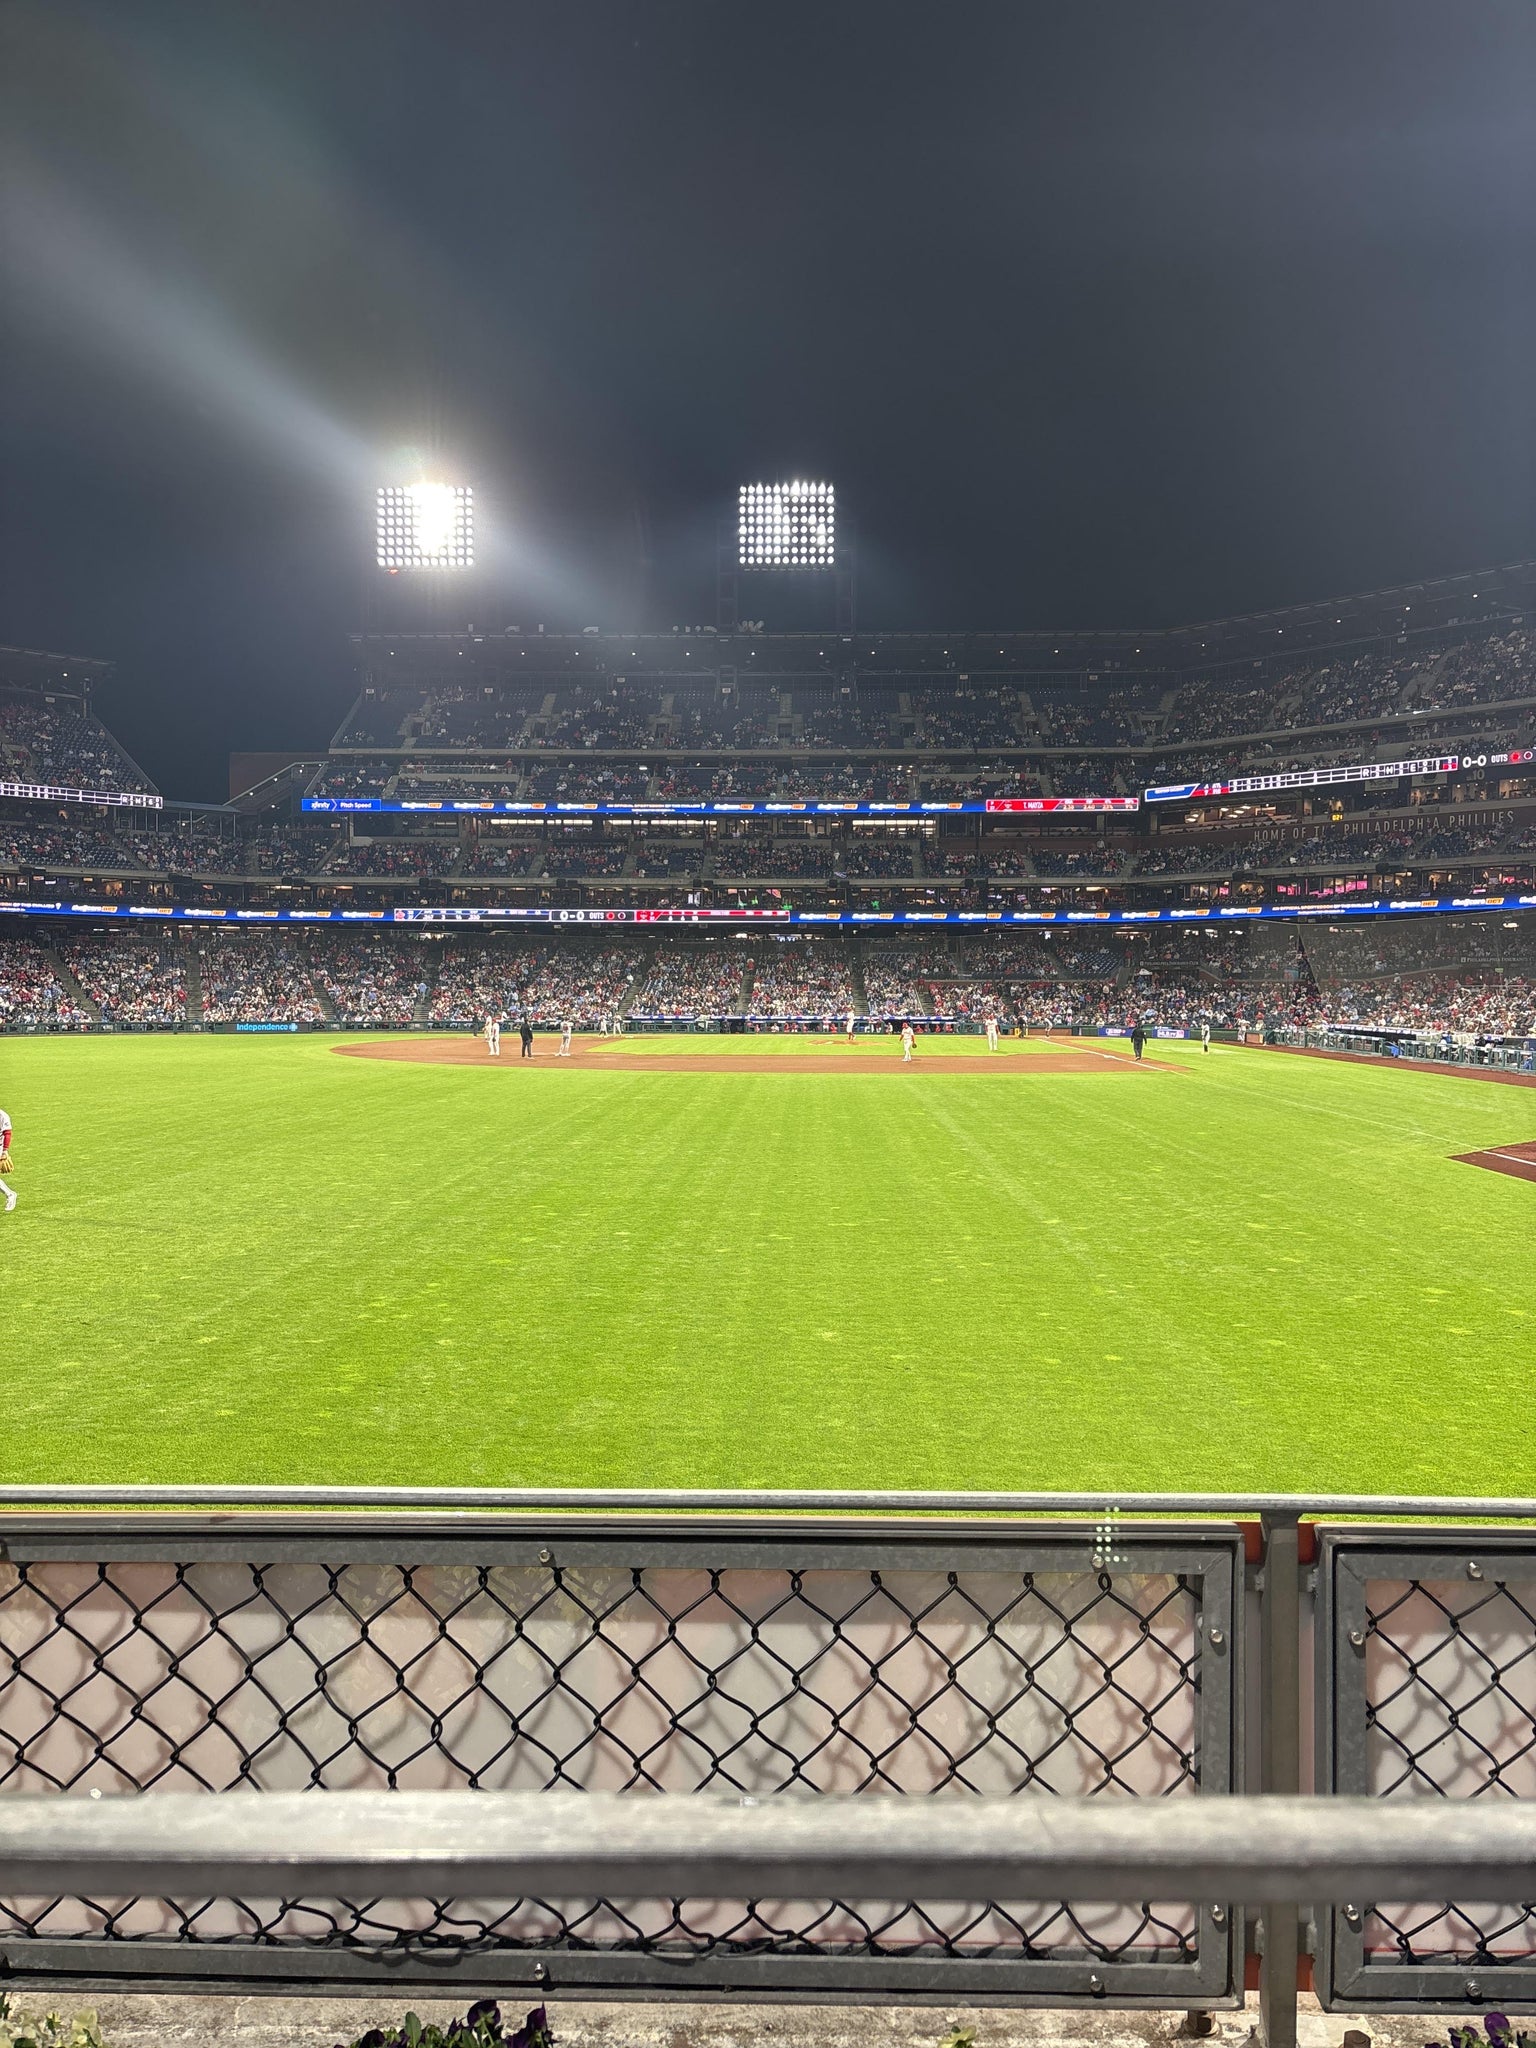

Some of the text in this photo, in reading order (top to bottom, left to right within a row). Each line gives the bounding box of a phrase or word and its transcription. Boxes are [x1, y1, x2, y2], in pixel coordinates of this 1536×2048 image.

[1463, 755, 1487, 768] 0-0
[1491, 753, 1508, 763] OUTS
[1473, 769, 1485, 780] 10
[1254, 829, 1286, 841] HOME
[1293, 827, 1306, 839] OF
[1449, 810, 1514, 827] PHILLIES
[560, 911, 584, 920] 0-0
[236, 1023, 288, 1031] Independence
